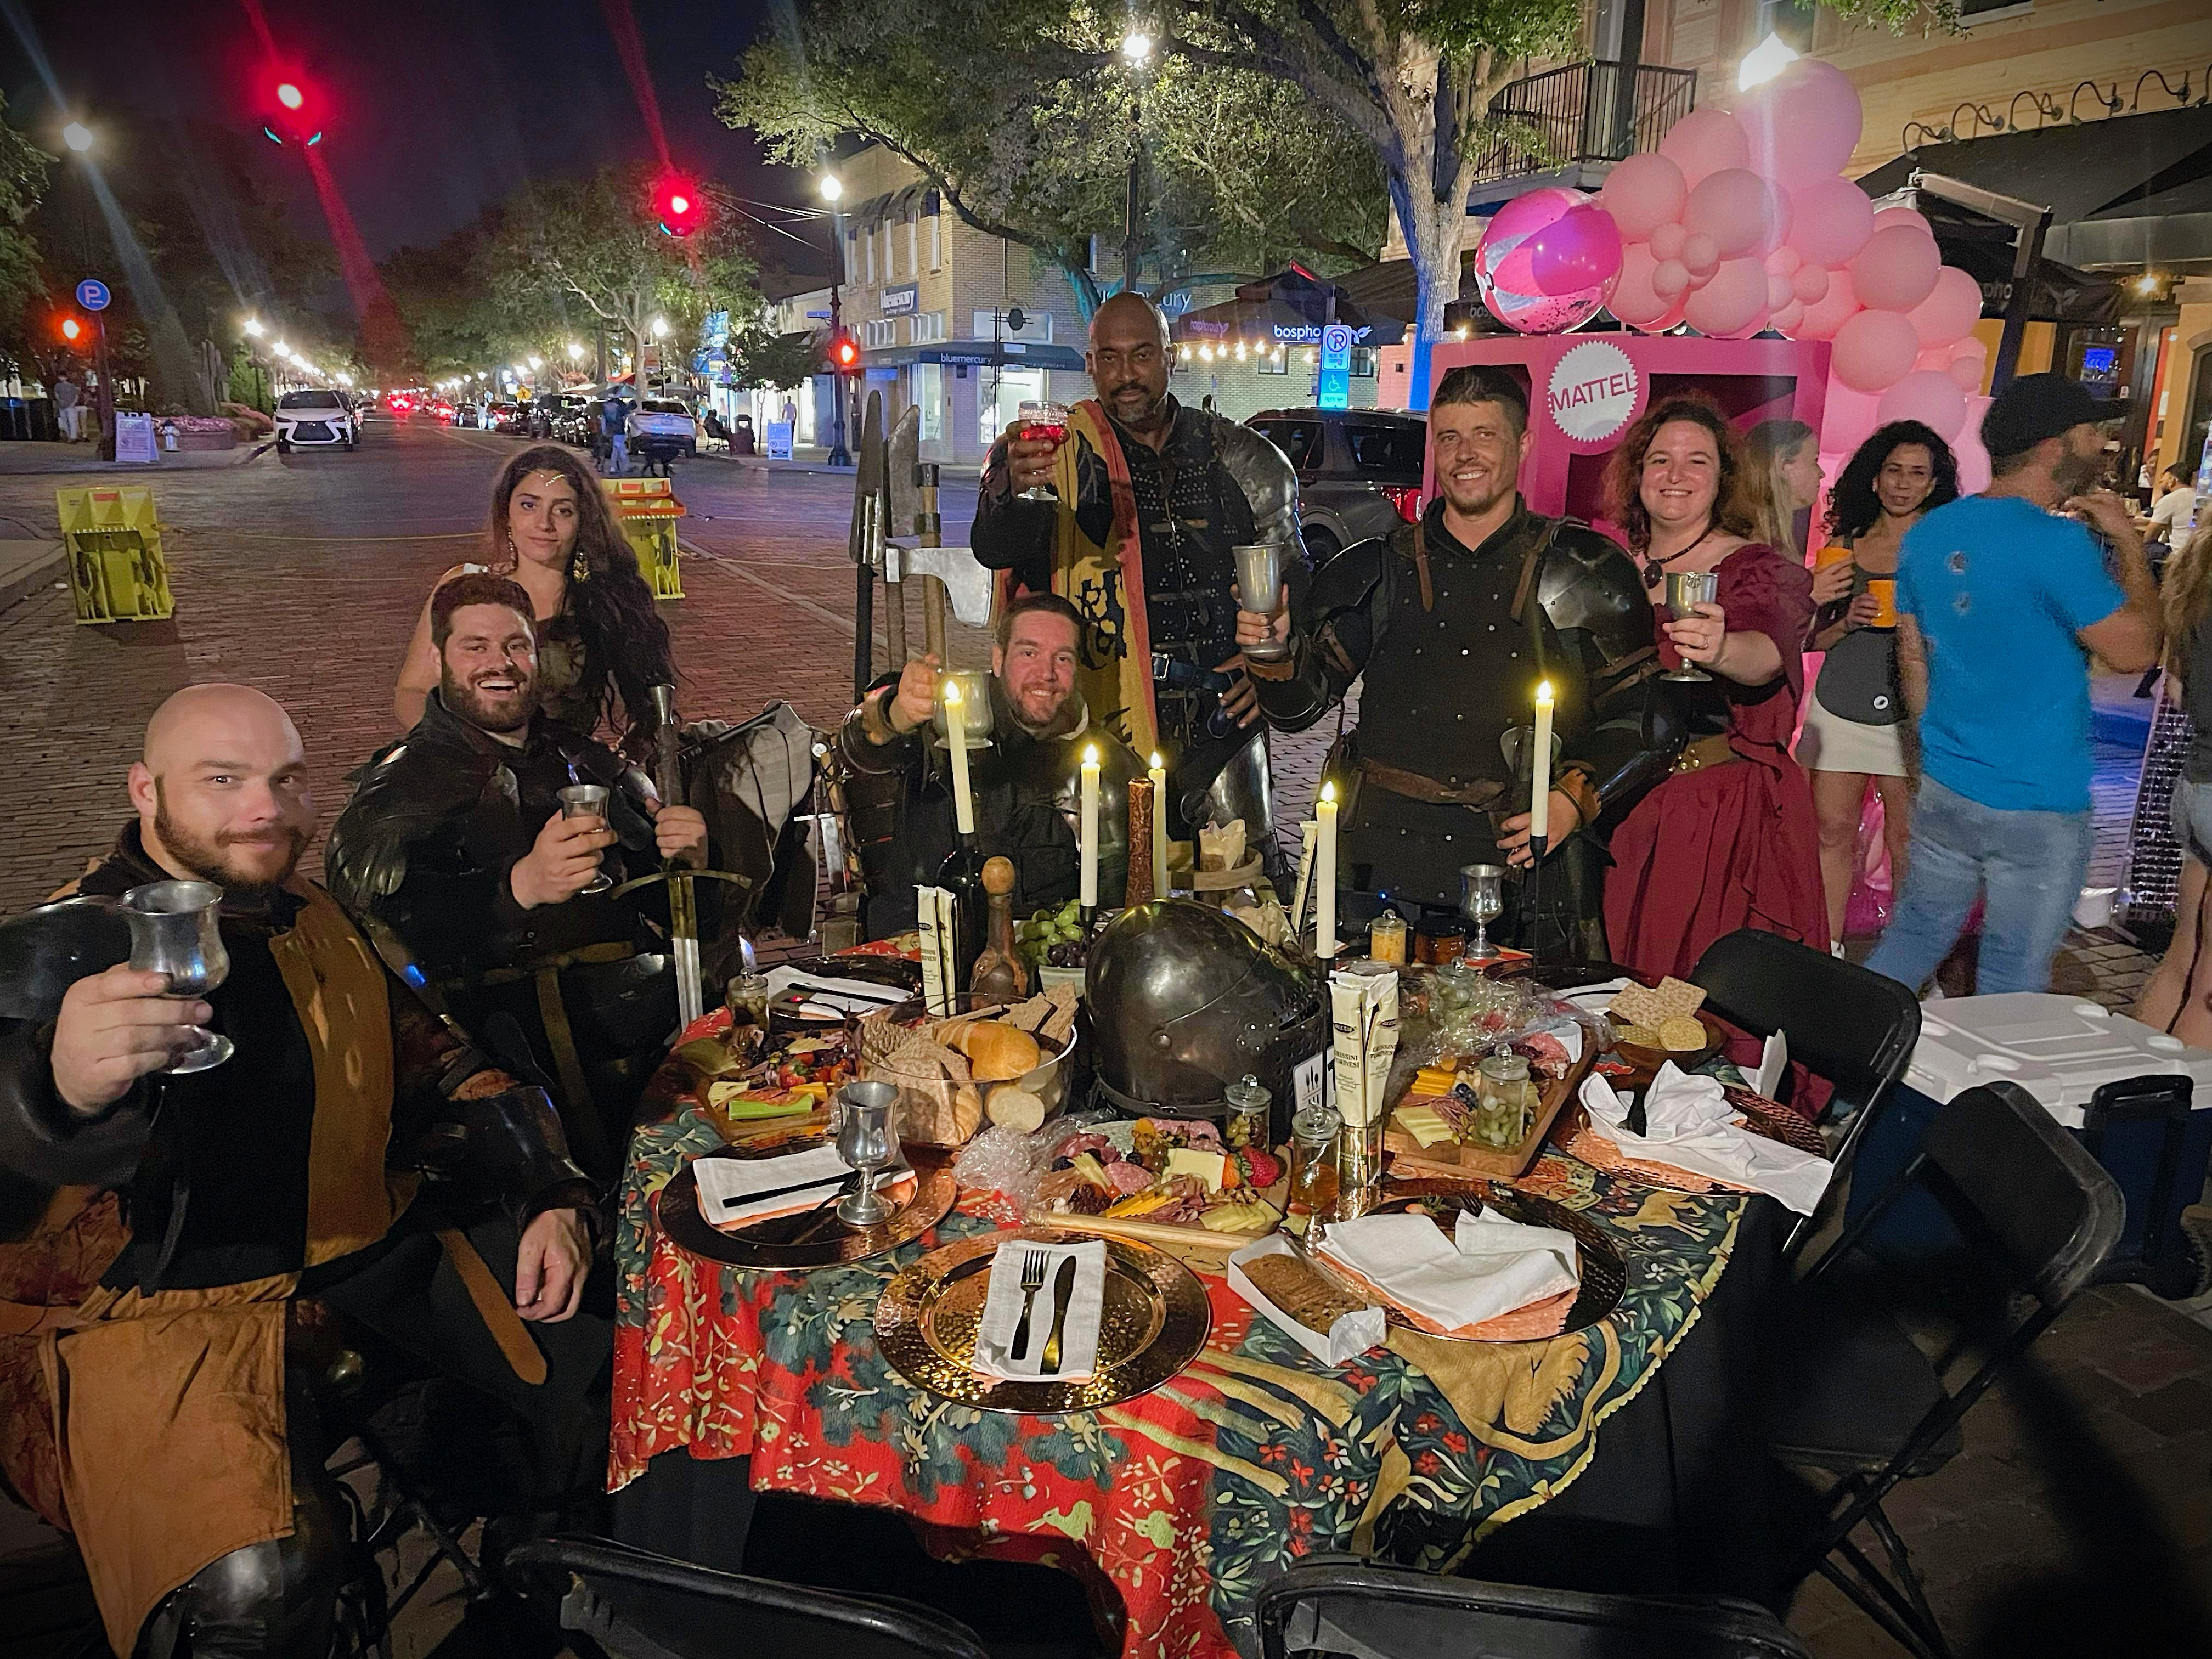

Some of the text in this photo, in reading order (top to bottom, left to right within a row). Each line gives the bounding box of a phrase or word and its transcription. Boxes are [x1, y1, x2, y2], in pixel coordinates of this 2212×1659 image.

[1274, 325, 1322, 340] bospho
[940, 353, 992, 365] bluemercury
[1550, 371, 1639, 413] MATTEL
